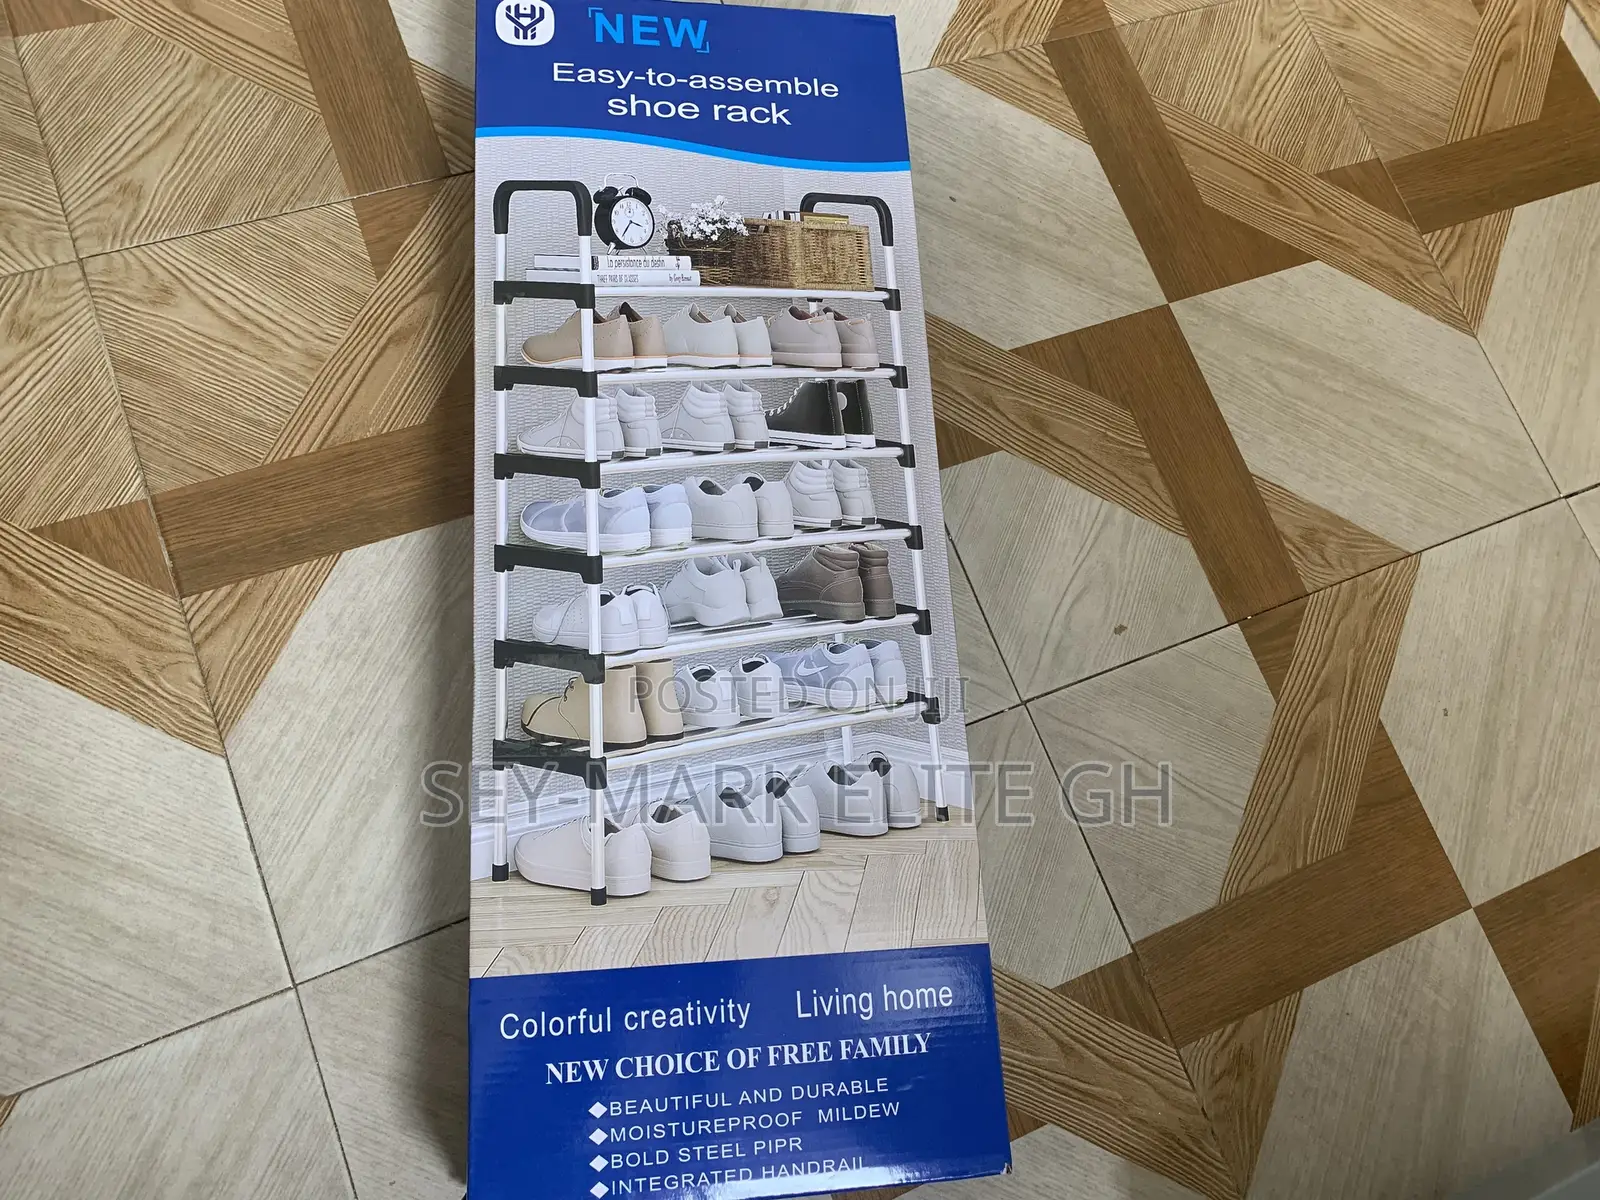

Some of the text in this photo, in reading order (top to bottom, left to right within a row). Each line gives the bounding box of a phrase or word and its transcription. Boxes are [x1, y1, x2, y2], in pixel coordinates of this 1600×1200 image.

[594, 12, 708, 49] NEW
[553, 62, 839, 98] Easy-to-assemble
[607, 94, 792, 126] shoe rack
[500, 998, 751, 1040] Colorful creativity
[796, 984, 953, 1021] Living home
[545, 1032, 931, 1085] NEW CHOICE OF FREE FAMILY
[609, 1077, 889, 1116] BEAUTIFUL AND DURABLE
[610, 1102, 900, 1143] MOISTUREPROOF MILDEW
[611, 1137, 803, 1169] BOLD STEEL PIPR
[612, 1168, 753, 1195] INTEGRATED
